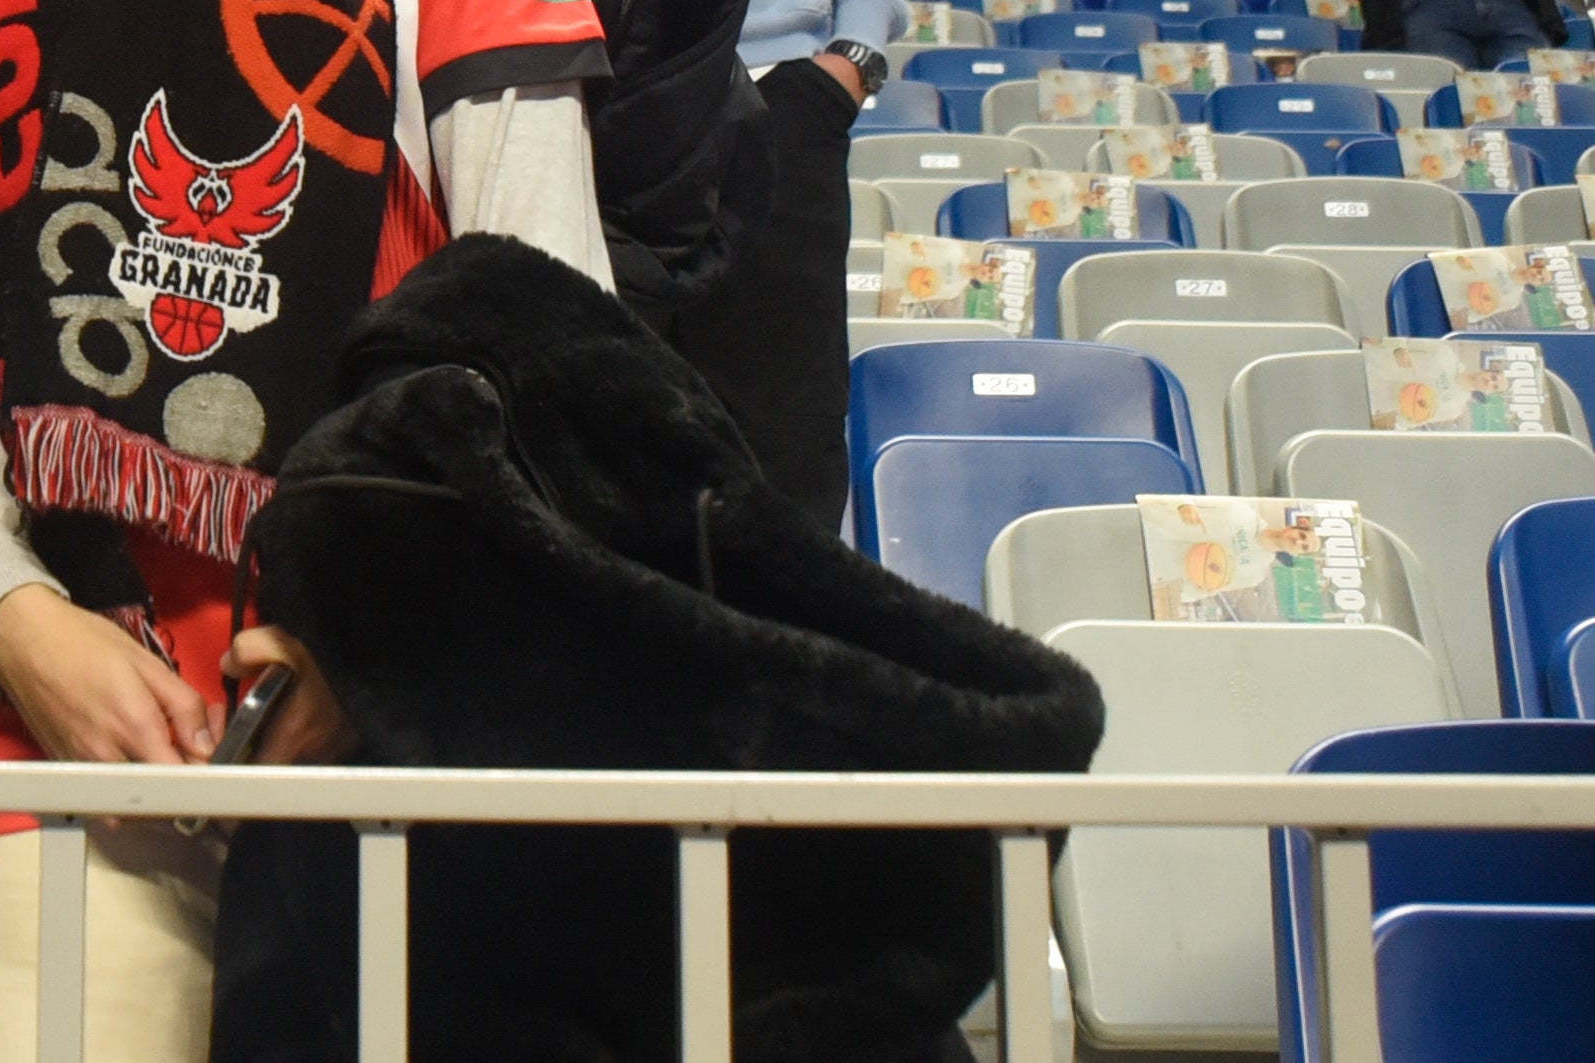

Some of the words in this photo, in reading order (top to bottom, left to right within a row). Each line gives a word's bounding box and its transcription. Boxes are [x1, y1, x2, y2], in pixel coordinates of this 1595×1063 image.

[1334, 202, 1358, 216] 28
[119, 248, 271, 315] GRANADA
[1187, 281, 1214, 296] 27
[988, 376, 1020, 394] 26
[1314, 502, 1366, 612] Equipo
